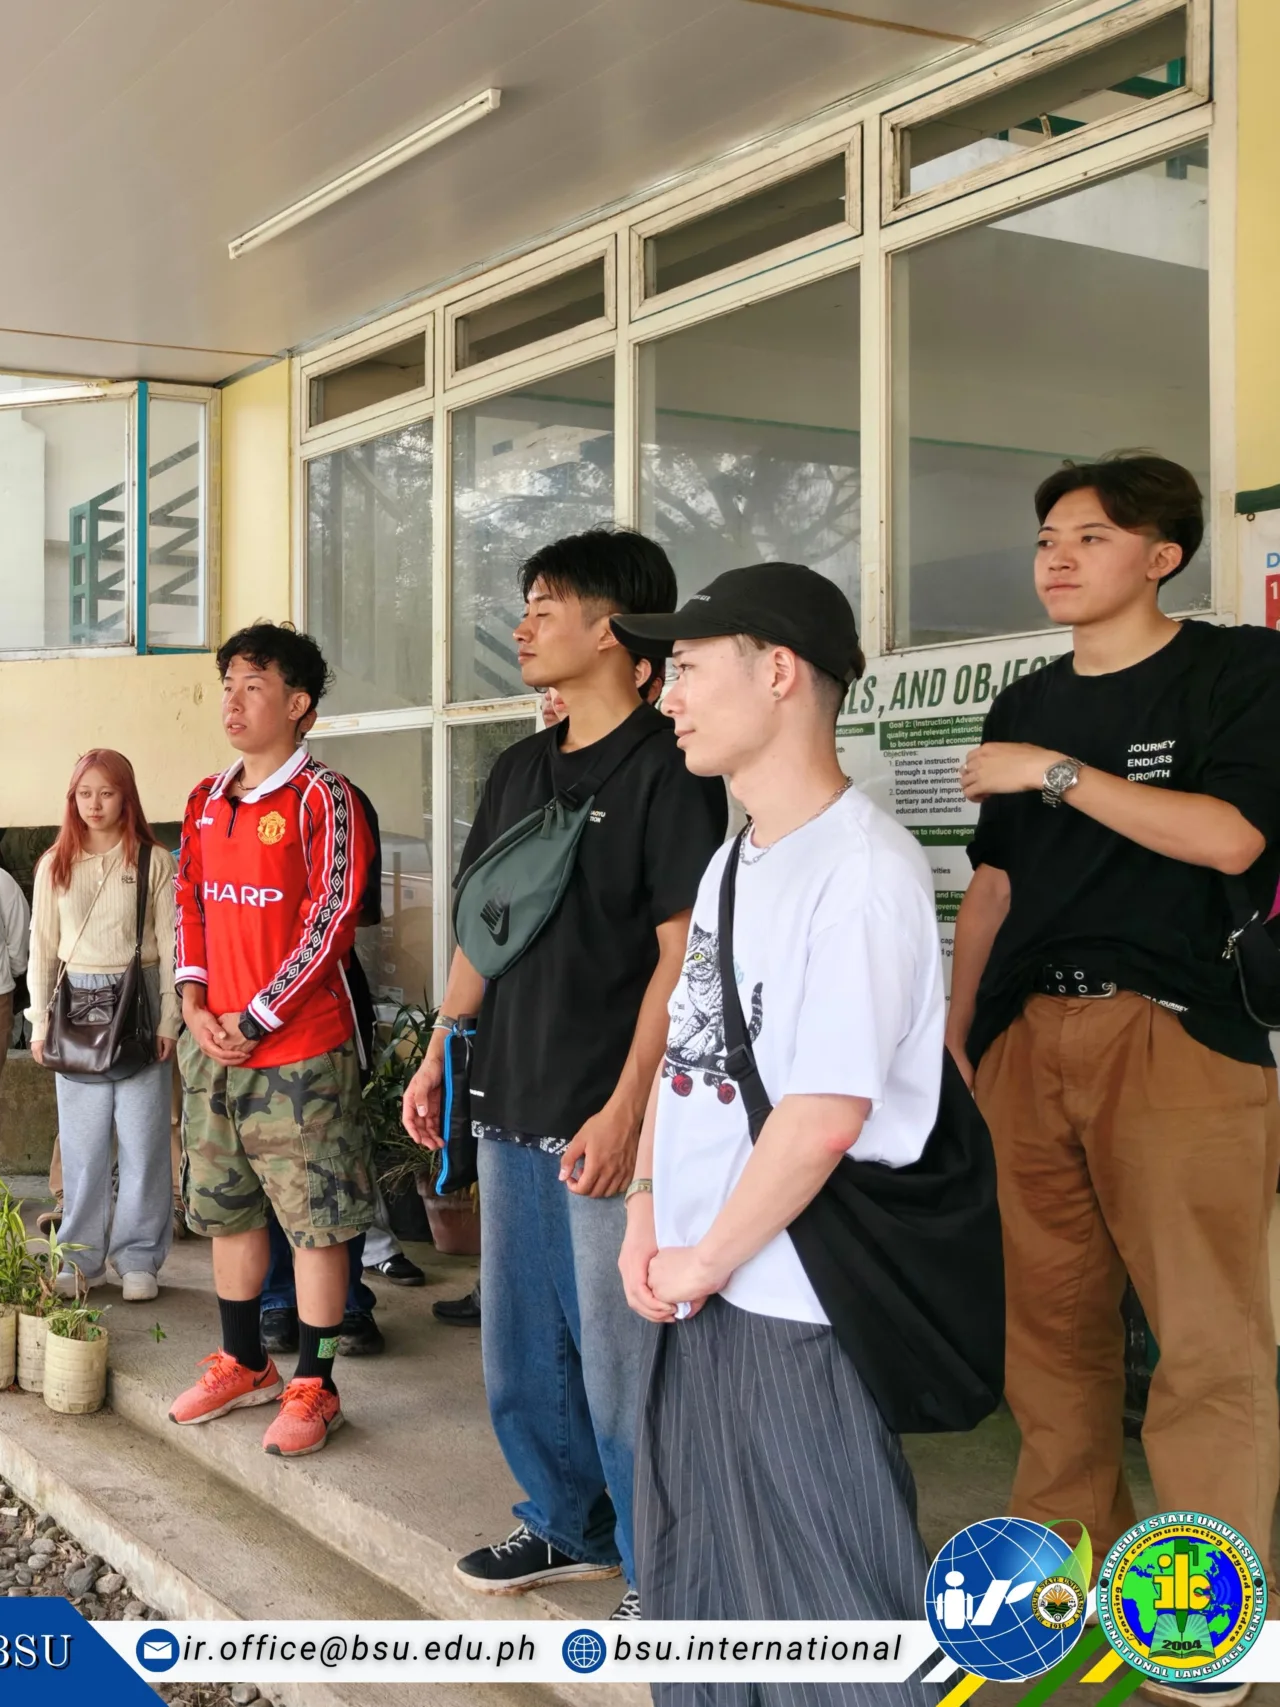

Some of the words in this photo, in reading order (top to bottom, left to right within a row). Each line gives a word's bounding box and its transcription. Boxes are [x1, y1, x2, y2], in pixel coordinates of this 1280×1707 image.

[888, 667, 947, 712] AND
[953, 654, 1063, 706] OBJE
[888, 721, 904, 729] Goal
[905, 720, 912, 728] 2:
[913, 717, 954, 729] (Instruction)
[955, 715, 984, 724] Advance
[886, 731, 909, 740] quality
[923, 728, 950, 736] relevant
[917, 737, 945, 748] regional
[1127, 739, 1176, 753] JOURNEY
[883, 749, 918, 759] Objectives:
[895, 759, 923, 767] Enhance
[924, 757, 960, 765] instruction
[1126, 754, 1173, 768] ENDLESS
[895, 767, 921, 777] through
[928, 767, 961, 776] supportiv
[1126, 769, 1170, 782] GROWTH
[895, 778, 929, 786] innovative
[895, 787, 938, 796] Continuously
[895, 798, 920, 806] tertiary
[921, 796, 933, 804] and
[934, 796, 967, 804] advanced
[895, 807, 928, 815] education
[929, 805, 962, 814] standards
[920, 828, 928, 836] to
[929, 827, 952, 836] reduce
[203, 881, 284, 908] HARP
